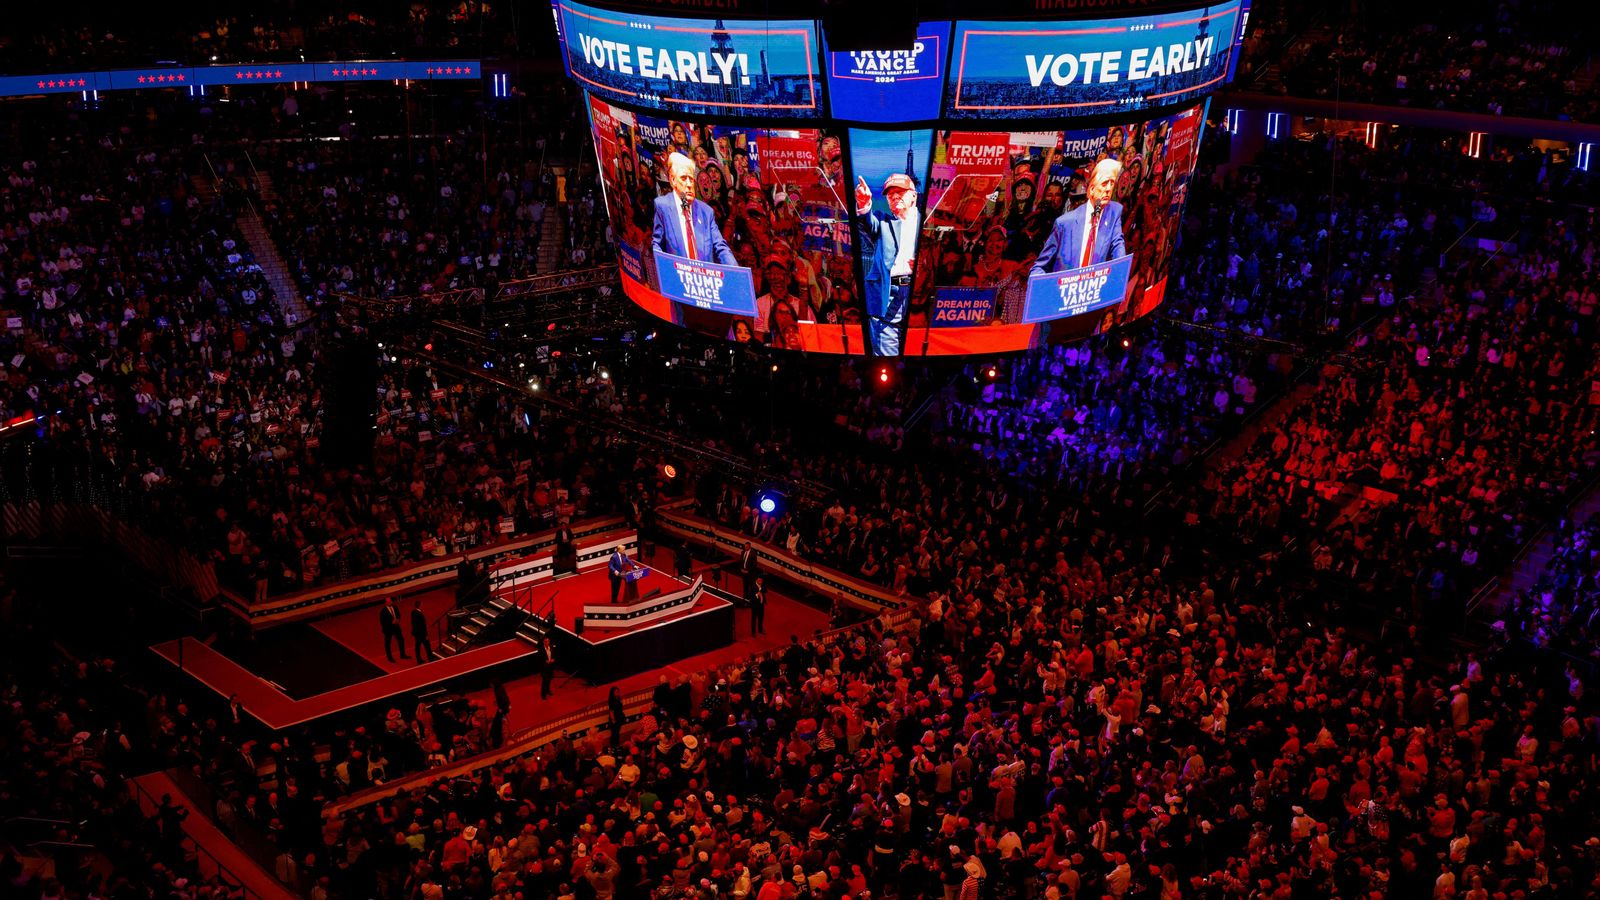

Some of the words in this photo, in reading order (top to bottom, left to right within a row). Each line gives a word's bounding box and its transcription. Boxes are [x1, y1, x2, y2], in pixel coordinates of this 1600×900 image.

[579, 32, 633, 73] VOTE
[637, 46, 750, 86] EARLY!
[855, 57, 916, 71] VANCE
[1025, 51, 1122, 87] VOTE
[1128, 36, 1215, 80] EARLY!
[638, 124, 669, 139] TRUMP
[952, 144, 1006, 158] TRUMP
[1065, 136, 1106, 152] TRUMP
[762, 150, 794, 159] DREAM
[796, 150, 816, 161] BIG,
[1084, 150, 1096, 158] FIX
[1096, 146, 1104, 154] IT
[950, 157, 974, 166] WILL
[976, 157, 994, 166] FIX
[994, 157, 1004, 166] IT
[676, 270, 723, 290] TRUMP
[1060, 274, 1080, 284] TRUMP
[1081, 272, 1094, 280] WILL
[683, 282, 720, 300] VANCE
[1059, 276, 1108, 298] TRUMP
[696, 300, 711, 308] 2024
[1063, 288, 1101, 306] VANCE
[936, 300, 972, 308] DREAM
[972, 300, 992, 310] BIG,
[1072, 306, 1088, 315] 2024
[935, 310, 986, 320] AGAIN!
